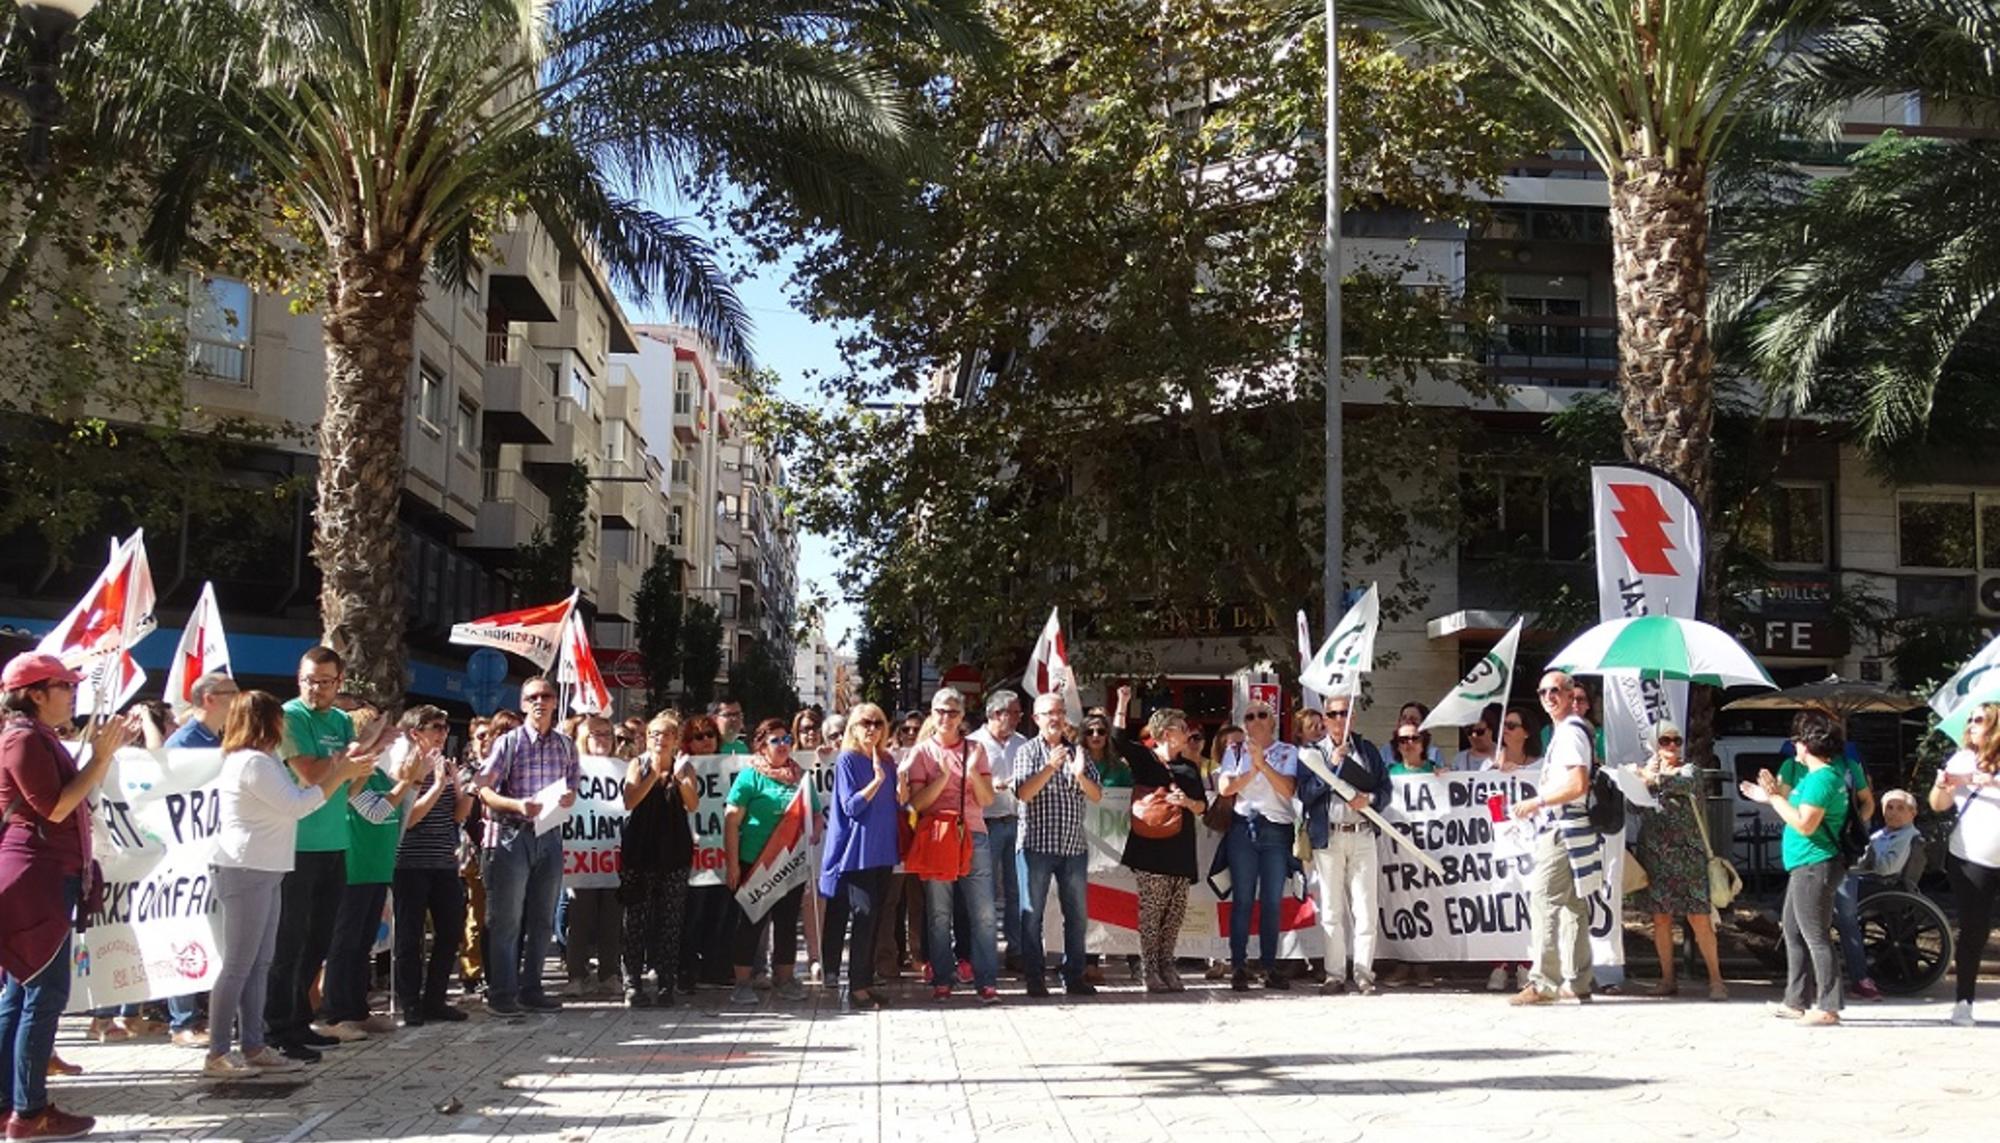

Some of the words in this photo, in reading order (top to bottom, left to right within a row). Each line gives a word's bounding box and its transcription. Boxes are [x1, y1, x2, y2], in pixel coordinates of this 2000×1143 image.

[1404, 783, 1436, 811] LA
[1448, 776, 1538, 807] DIGNID
[165, 788, 221, 844] PRO
[695, 811, 721, 836] LA
[1391, 817, 1495, 854] RECONO
[1379, 900, 1433, 941] L@S
